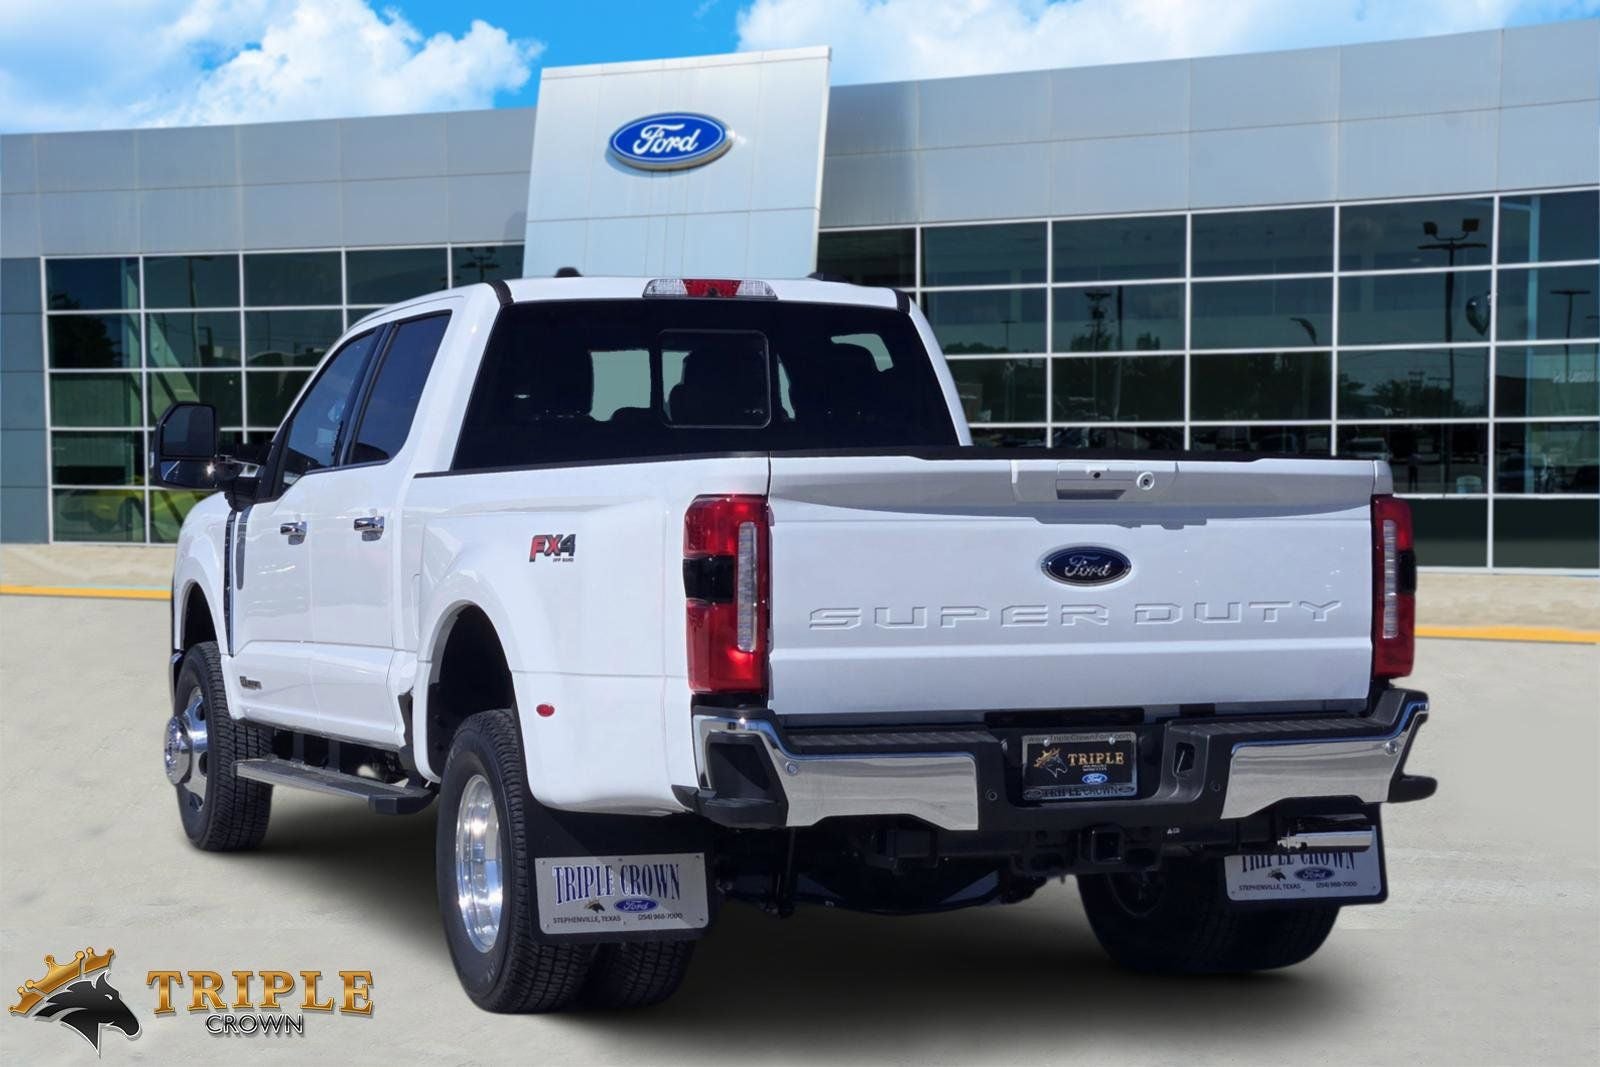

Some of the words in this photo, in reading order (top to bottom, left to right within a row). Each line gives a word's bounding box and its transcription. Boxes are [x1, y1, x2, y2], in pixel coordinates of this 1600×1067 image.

[632, 123, 701, 155] Ford
[529, 534, 576, 562] FX4
[1064, 555, 1112, 577] Ford
[809, 603, 1111, 631] SUPER
[1134, 600, 1343, 626] DUTY
[1067, 751, 1125, 767] TRIPLE
[553, 864, 615, 905] TRIPLE
[620, 863, 681, 901] CROWN
[1303, 868, 1327, 880] Ford
[623, 899, 649, 911] Ford
[553, 915, 600, 924] STEPHENVILLE,
[601, 914, 621, 922] TEXAS
